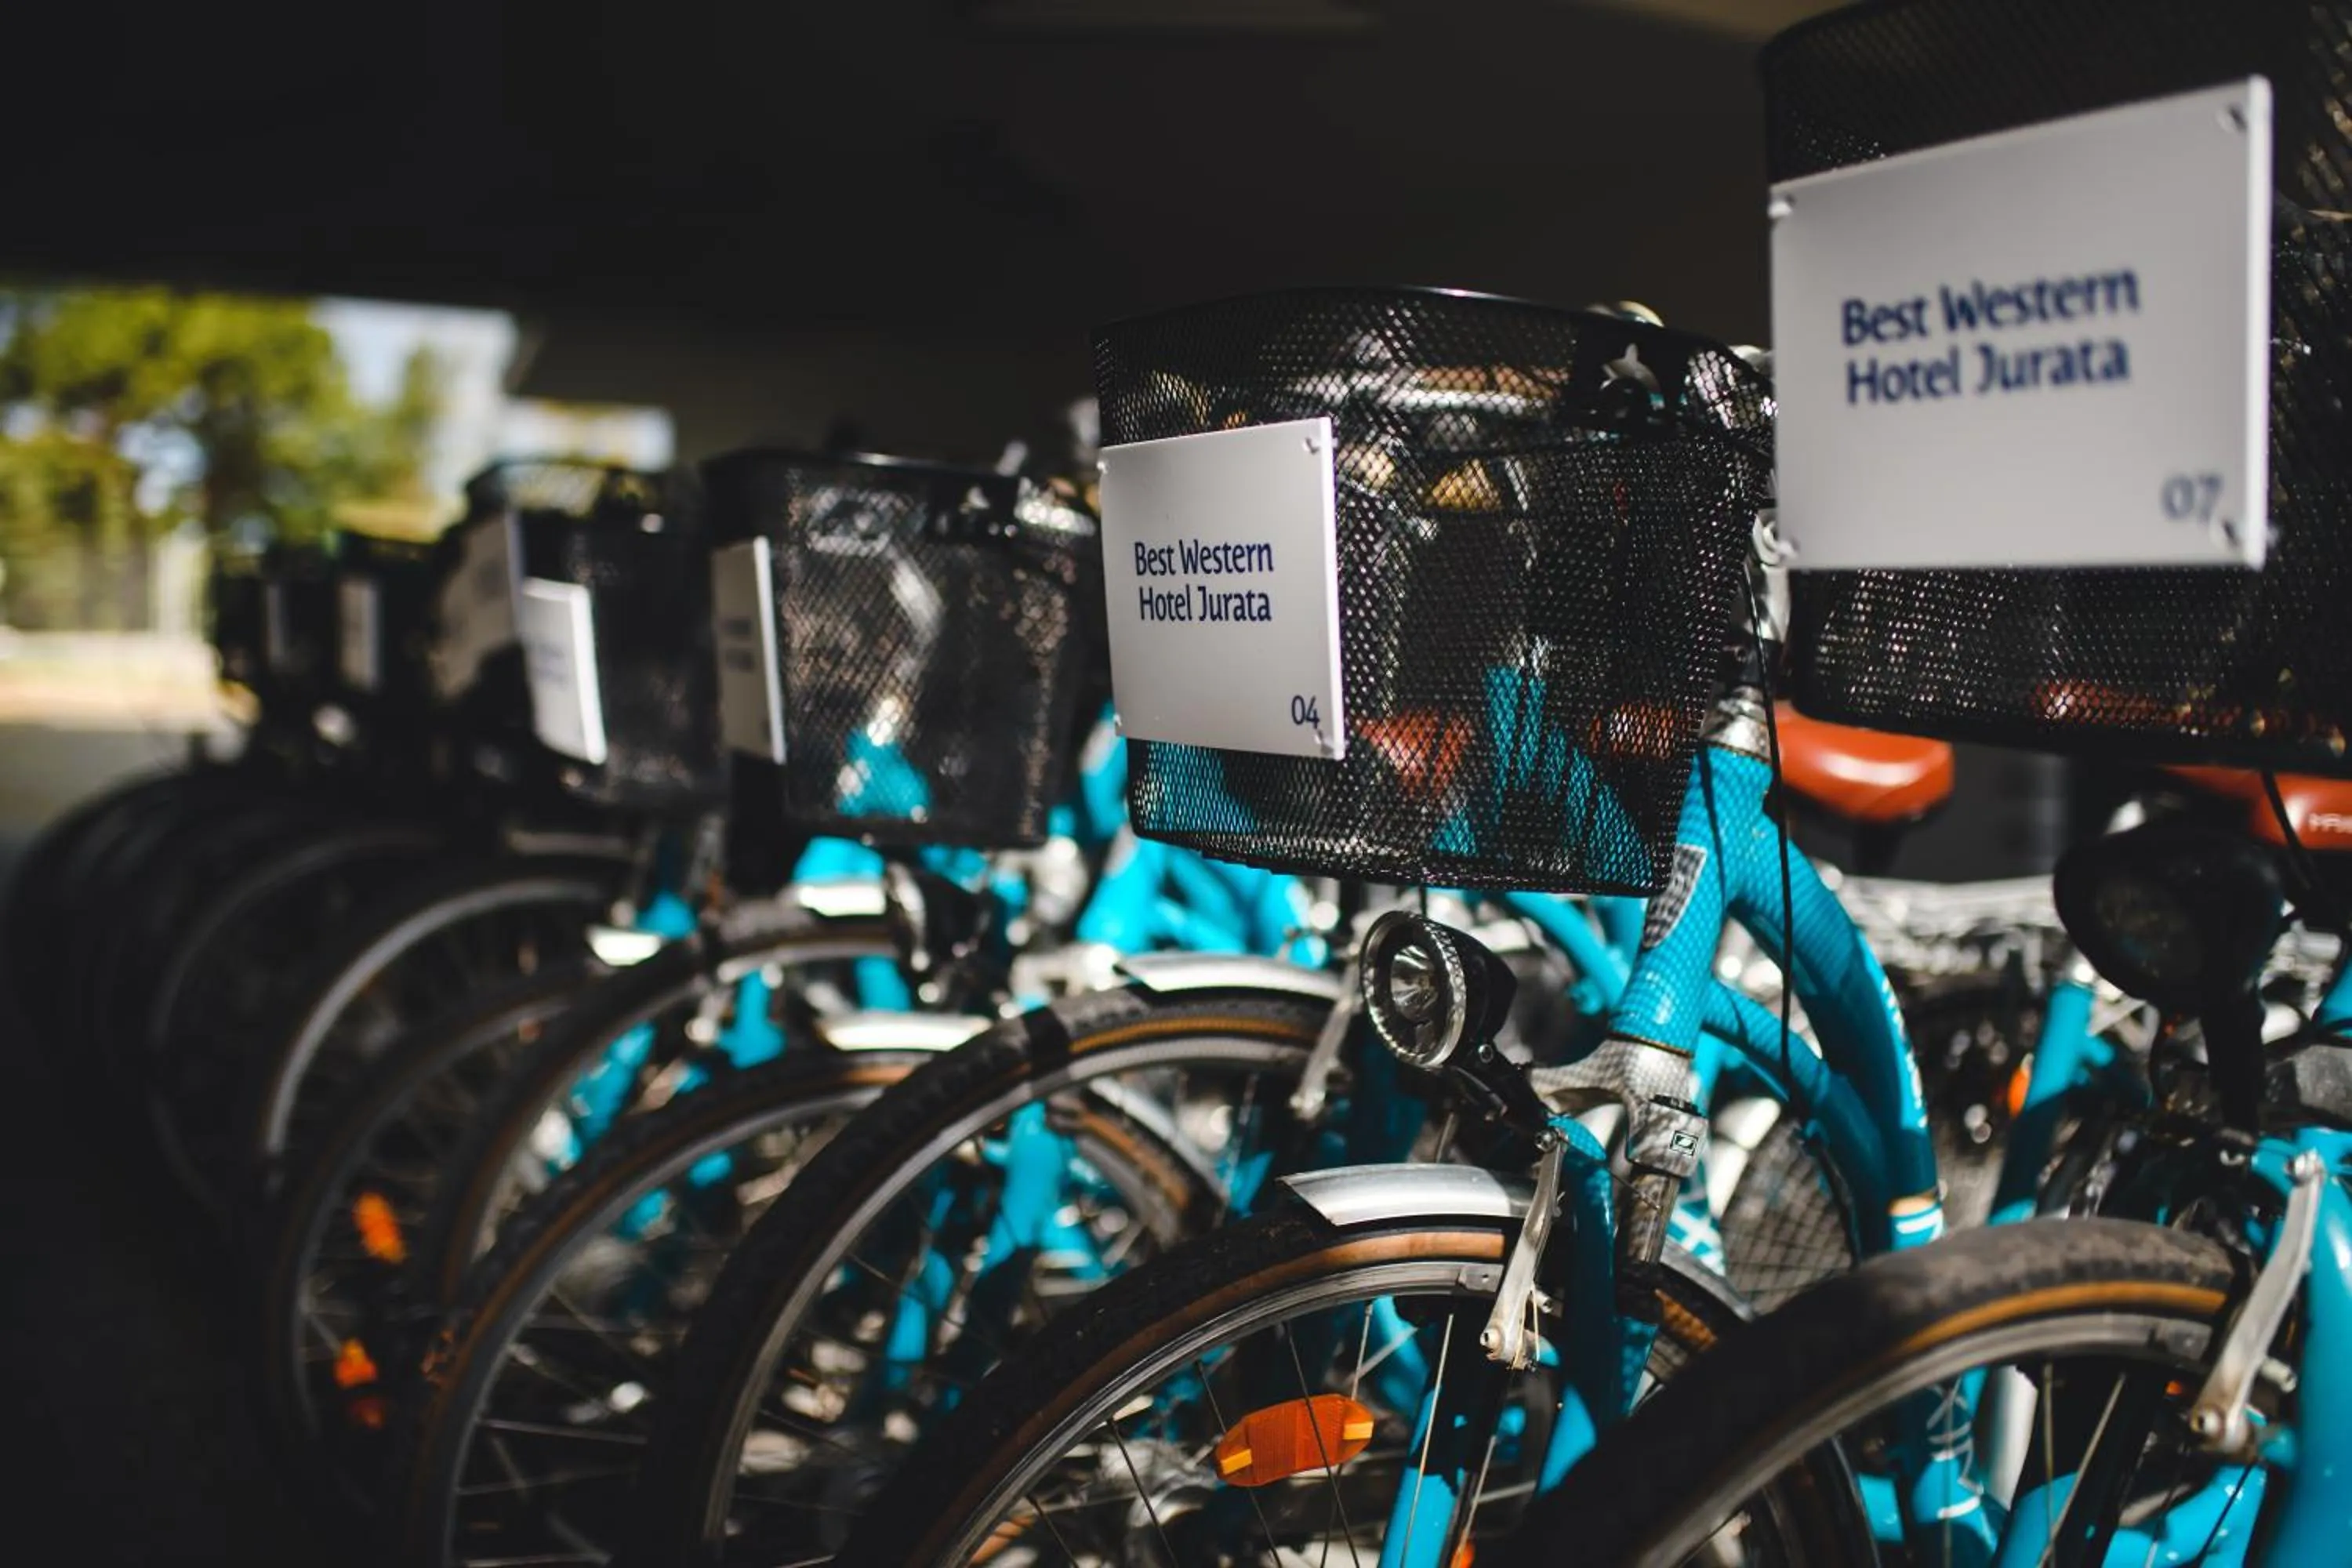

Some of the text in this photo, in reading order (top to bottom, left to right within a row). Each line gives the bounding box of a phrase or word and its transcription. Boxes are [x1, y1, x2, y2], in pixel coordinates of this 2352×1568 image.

[1841, 269, 2139, 347] Best Western
[1847, 339, 2129, 405] Hotel Jurata
[2161, 474, 2223, 524] 07
[1134, 539, 1274, 576] Best Western
[1138, 584, 1272, 622] Hotel Jurata
[1291, 695, 1320, 729] 04
